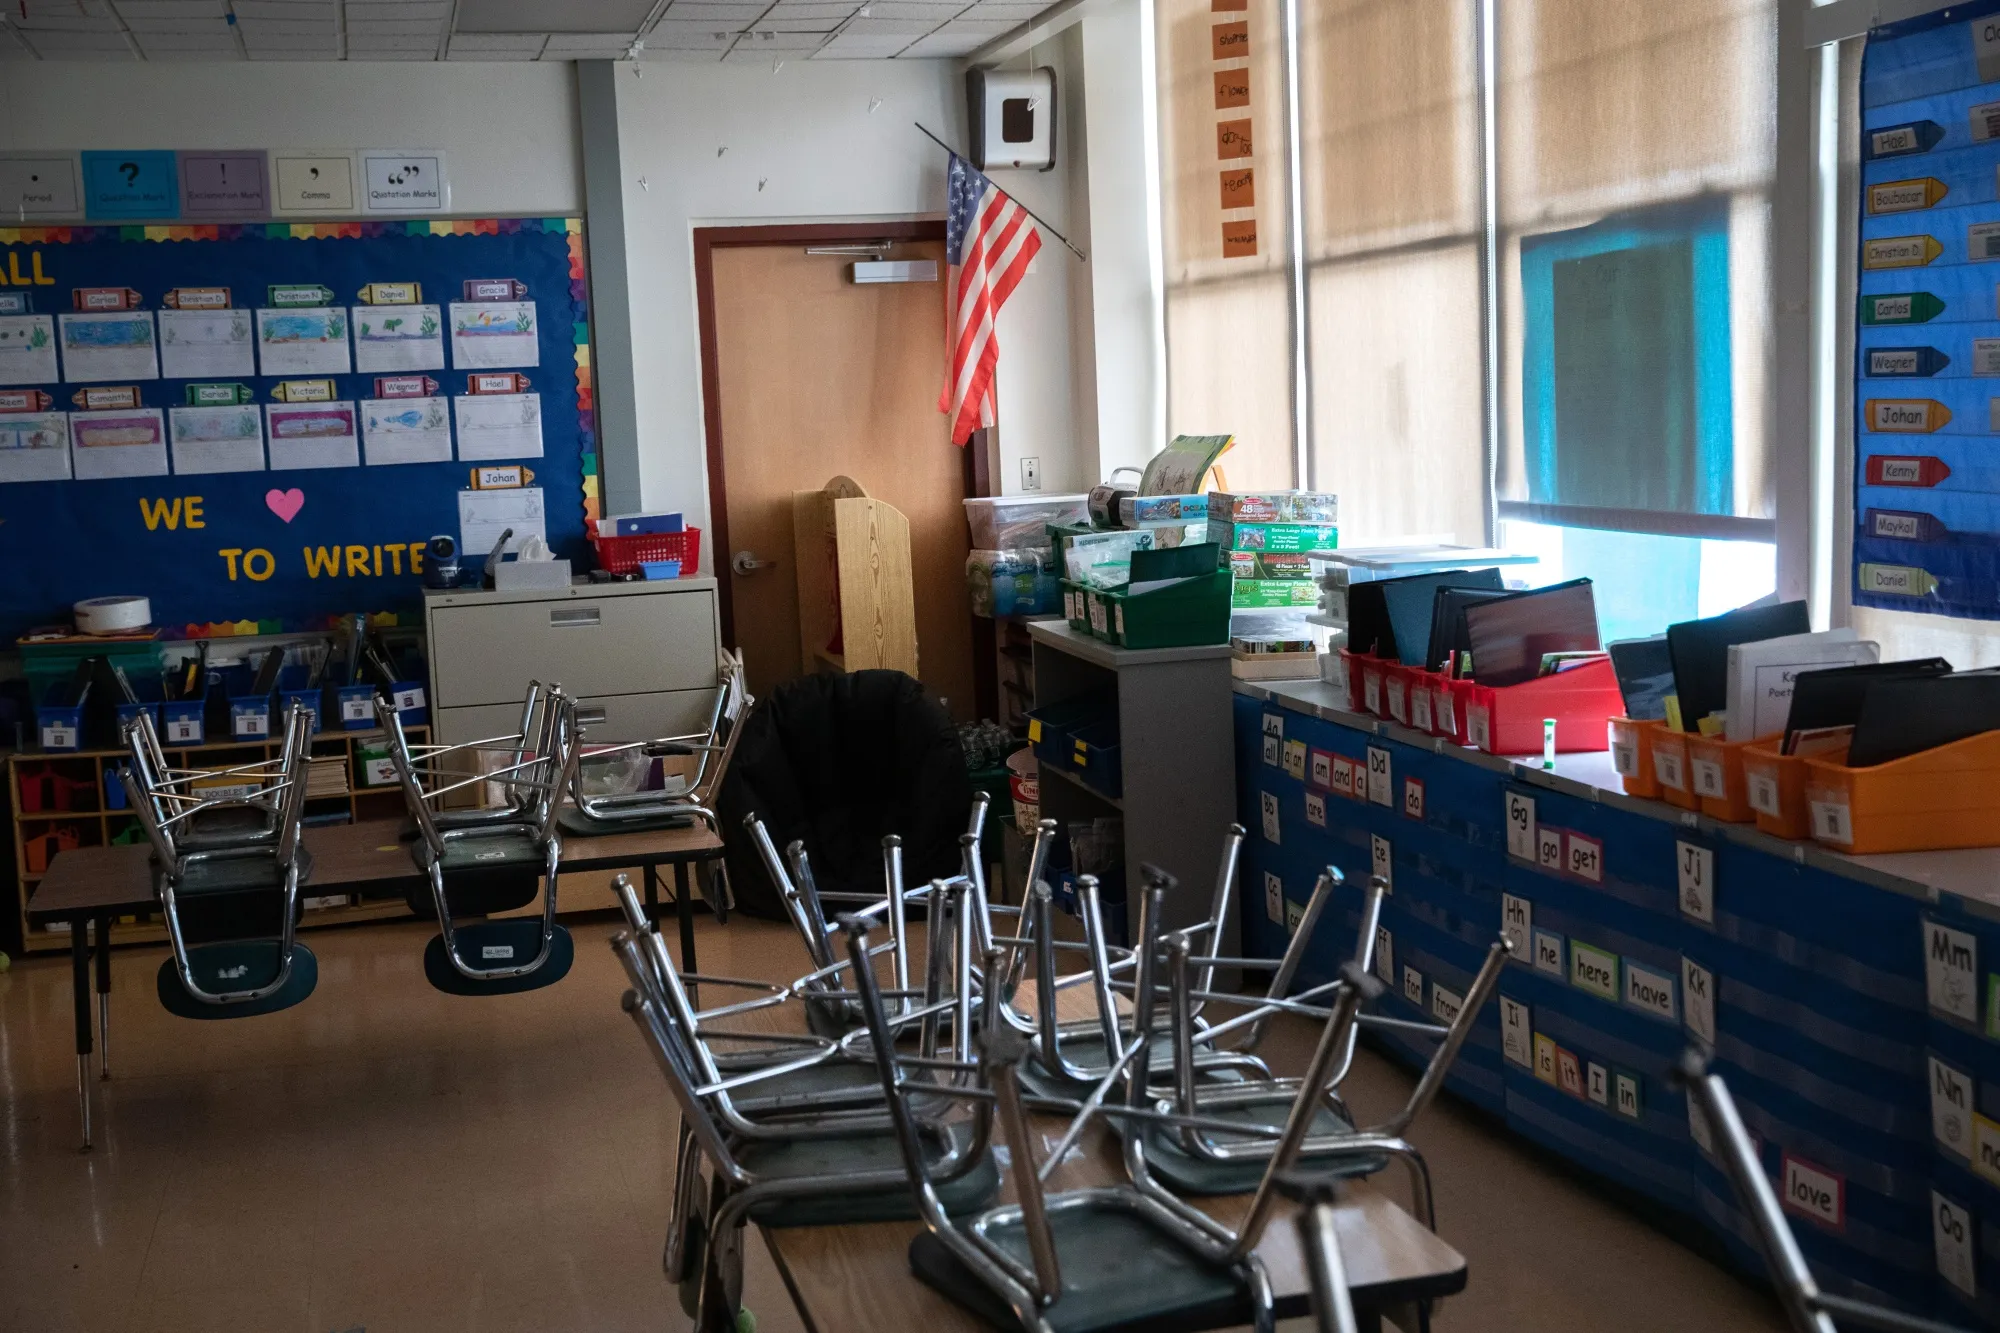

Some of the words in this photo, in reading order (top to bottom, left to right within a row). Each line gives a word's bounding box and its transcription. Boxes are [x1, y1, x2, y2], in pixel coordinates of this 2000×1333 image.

[1880, 131, 1908, 150] Hael
[23, 193, 52, 202] Period
[100, 193, 141, 203] Question
[143, 193, 165, 202] Mark
[187, 191, 238, 200] Exclamation
[240, 191, 261, 200] Mark
[301, 190, 331, 200] Comma
[371, 190, 411, 201] Quotation
[413, 190, 438, 199] Marks
[1869, 244, 1910, 260] Christian
[276, 291, 310, 301] Christian
[380, 289, 406, 299] Daniel
[479, 285, 506, 295] Gracie
[1876, 299, 1909, 317] Carlos
[1873, 354, 1916, 373] Wegner
[291, 387, 325, 396] Victoria
[387, 383, 419, 393] Wegner
[485, 379, 504, 388] Hael
[1881, 406, 1923, 425] Johan
[485, 472, 517, 485] Johan
[1885, 462, 1917, 480] Kenny
[139, 495, 206, 531] WE
[1241, 504, 1253, 514] 48
[1877, 517, 1915, 535] Maykal
[218, 547, 276, 582] TO
[303, 542, 427, 578] WRITE
[1876, 571, 1907, 588] Daniel
[1266, 720, 1278, 736] Aa
[1265, 743, 1277, 760] all
[1293, 753, 1302, 767] an
[1315, 761, 1329, 777] am
[1334, 767, 1350, 785] and
[1357, 776, 1364, 788] a
[1371, 750, 1386, 774] Dd
[1408, 788, 1420, 807] do
[1264, 799, 1275, 815] Bb
[1308, 805, 1323, 819] are
[1511, 800, 1527, 830] Gg
[1542, 841, 1558, 861] go
[1572, 851, 1597, 872] get
[1375, 839, 1386, 862] Ee
[1684, 847, 1701, 887] Jj
[1268, 879, 1277, 897] Cc
[1507, 901, 1525, 926] Hh
[1541, 940, 1557, 965] he
[1577, 954, 1610, 988] here
[1631, 978, 1668, 1010] have
[1932, 929, 1973, 972] Mm
[1405, 973, 1420, 997] for
[1688, 965, 1705, 999] Kk
[1540, 1047, 1551, 1073] is
[1564, 1060, 1577, 1081] it
[1593, 1072, 1601, 1093] I
[1620, 1084, 1635, 1107] in
[1936, 1069, 1965, 1110] Nn
[1791, 1168, 1832, 1213] love
[1940, 1204, 1964, 1244] Oo
